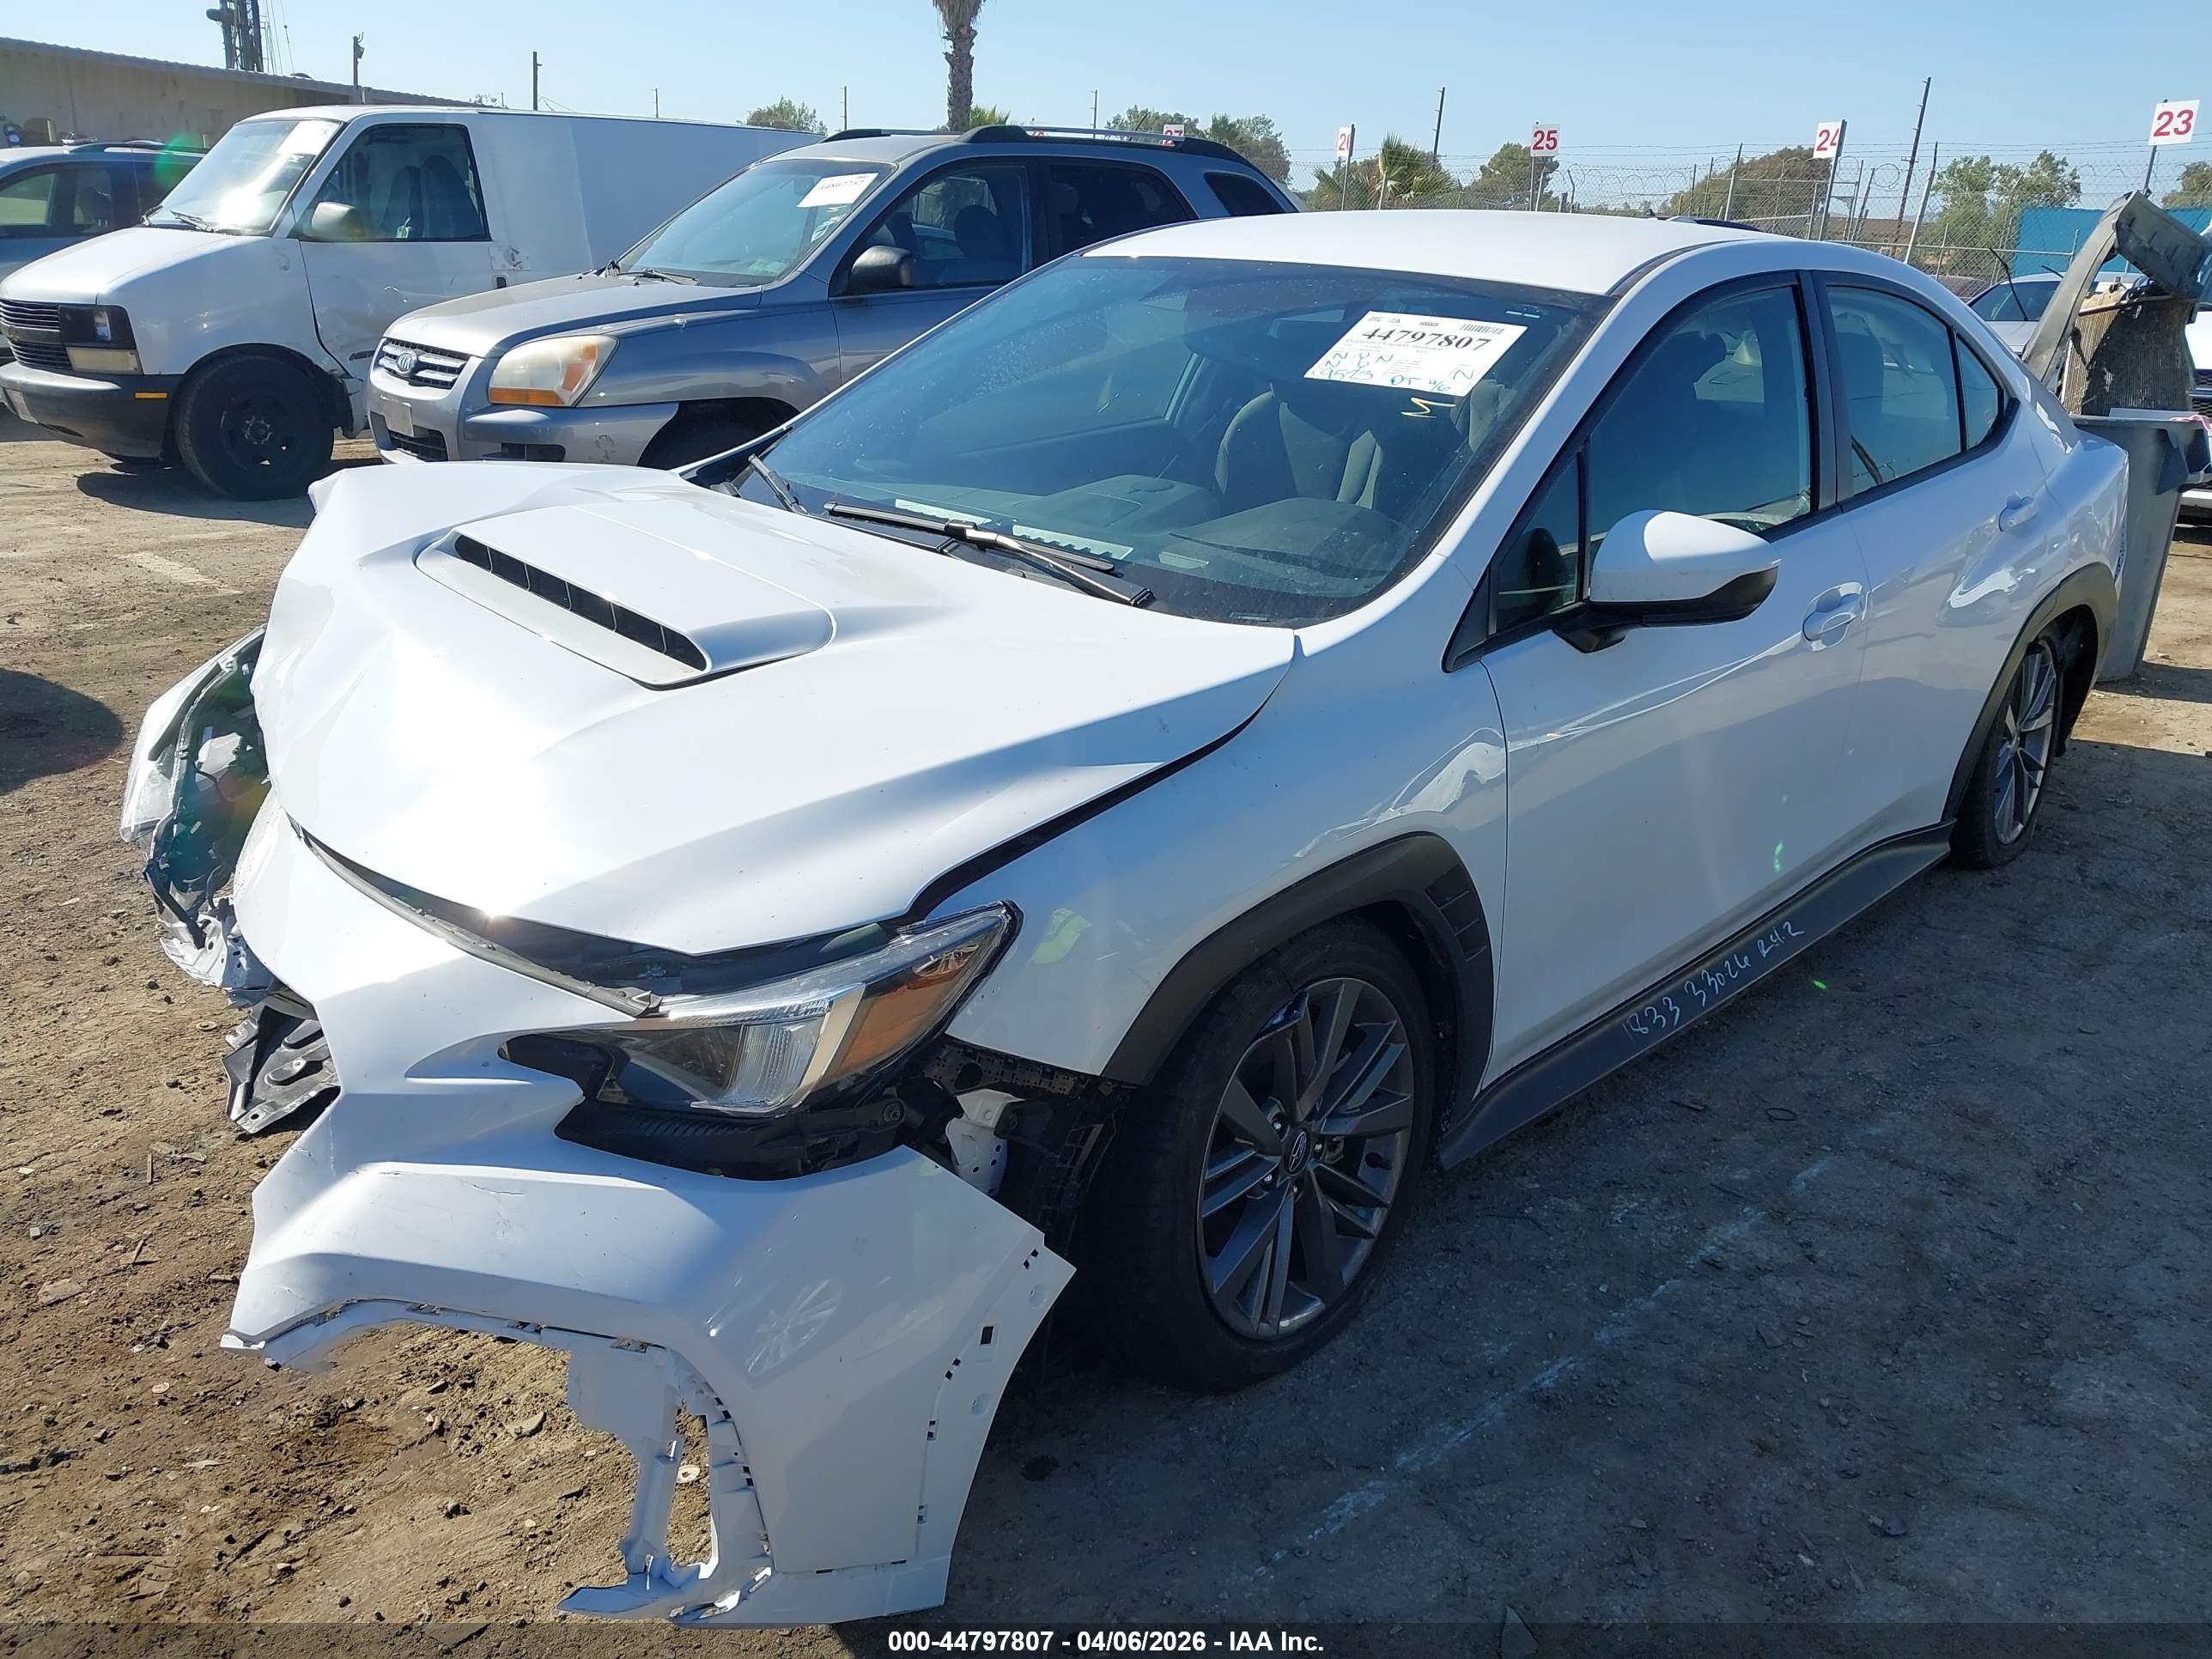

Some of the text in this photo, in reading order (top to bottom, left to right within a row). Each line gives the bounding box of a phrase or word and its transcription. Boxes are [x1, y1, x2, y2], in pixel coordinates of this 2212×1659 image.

[2153, 109, 2194, 137] 23
[1532, 130, 1558, 150] 25
[1362, 327, 1493, 351] 44797807
